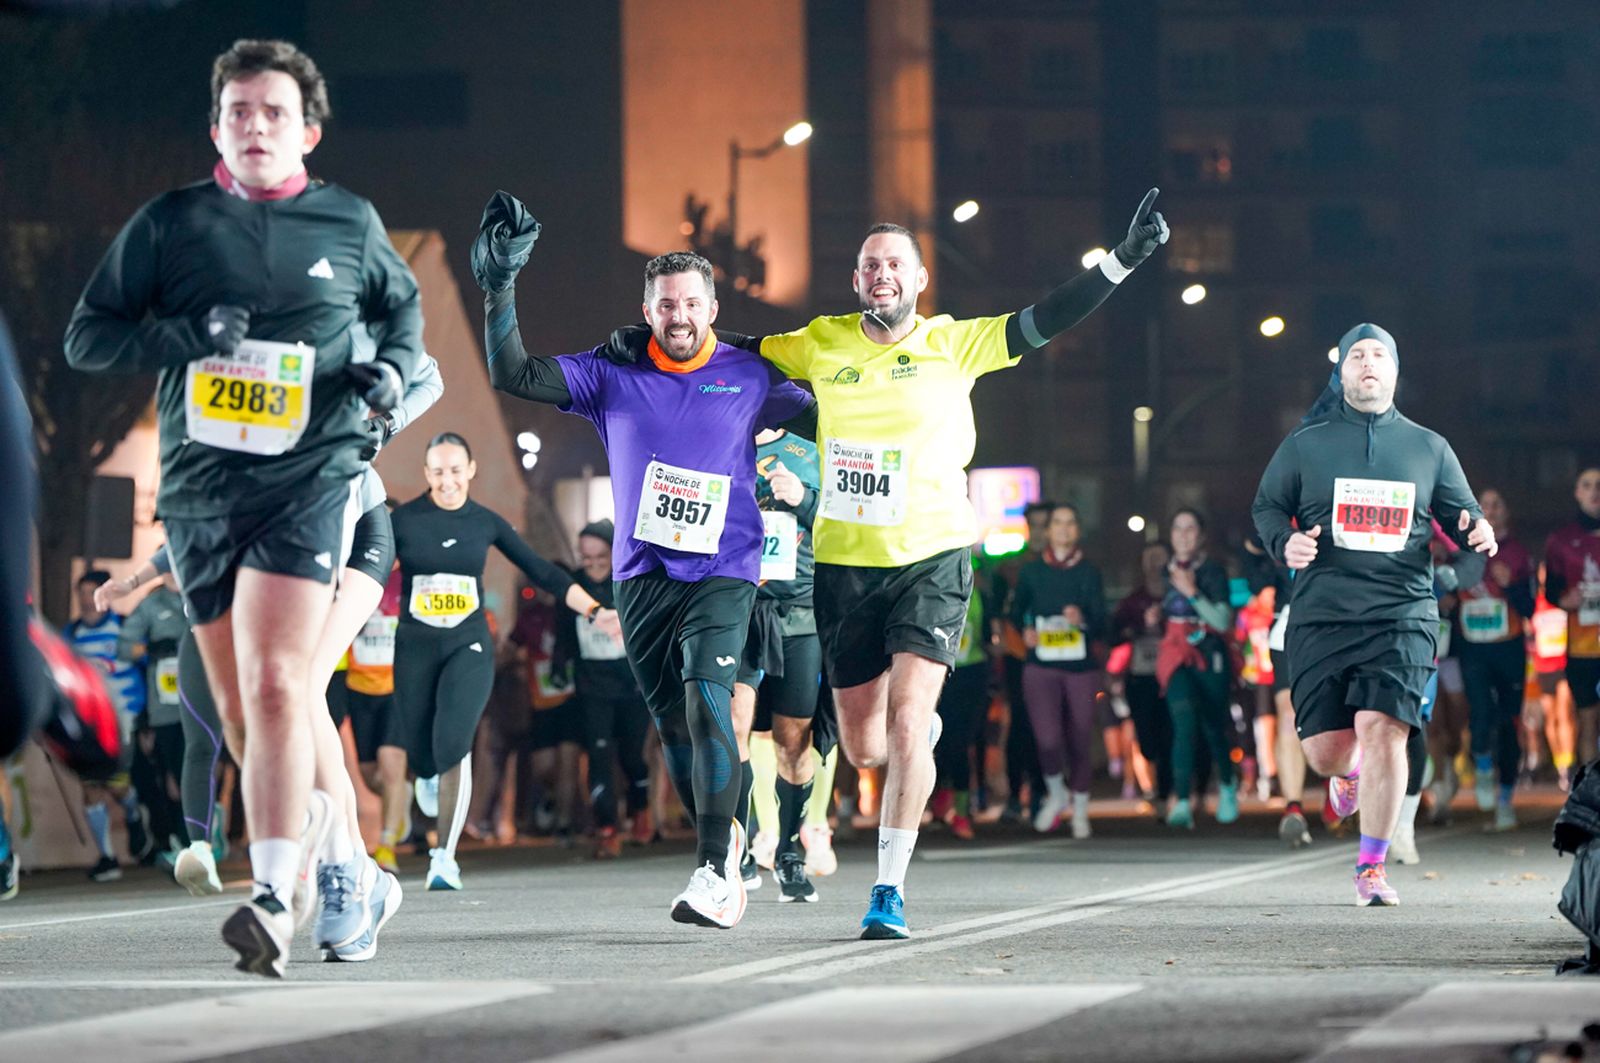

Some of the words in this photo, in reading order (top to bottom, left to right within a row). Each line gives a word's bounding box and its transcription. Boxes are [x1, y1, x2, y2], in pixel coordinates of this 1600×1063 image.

[208, 377, 287, 416] 2983
[841, 448, 863, 460] NOCHE
[863, 452, 874, 461] DE
[652, 481, 670, 493] SAN
[664, 474, 690, 487] NOCHE
[690, 480, 702, 489] DE
[836, 468, 891, 497] 3904
[655, 493, 713, 526] 3957
[1343, 504, 1404, 529] 13909
